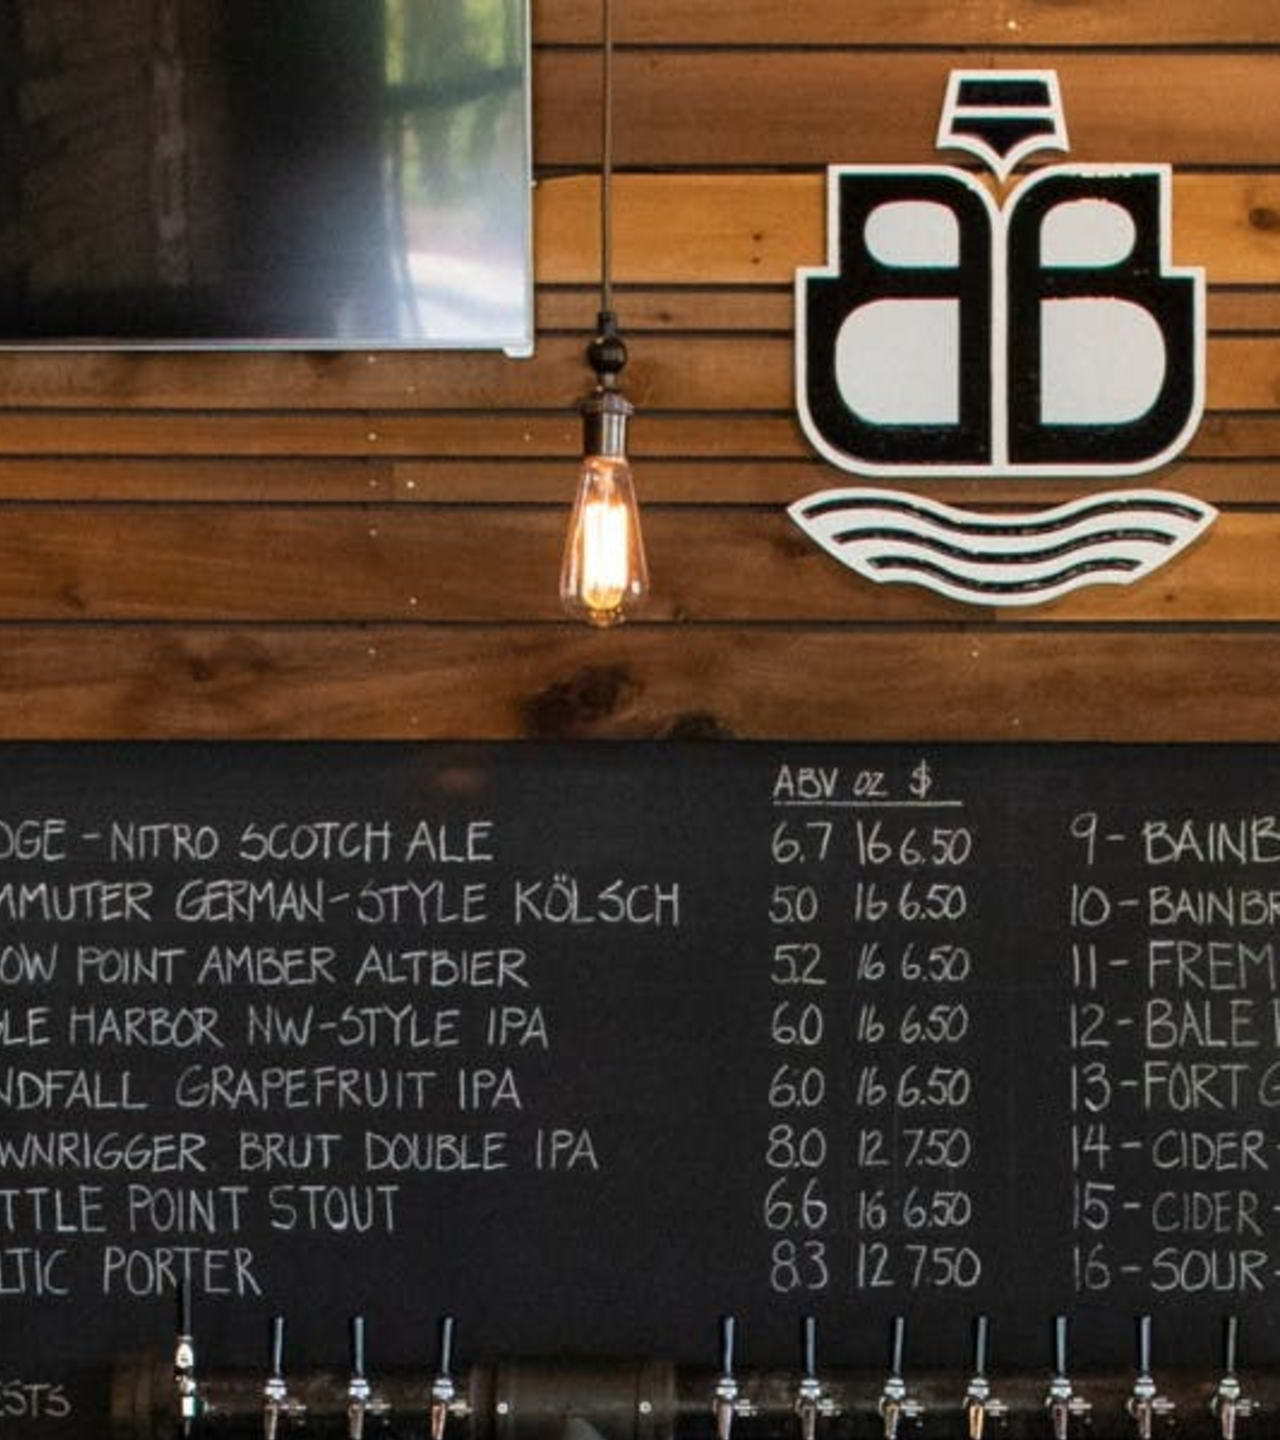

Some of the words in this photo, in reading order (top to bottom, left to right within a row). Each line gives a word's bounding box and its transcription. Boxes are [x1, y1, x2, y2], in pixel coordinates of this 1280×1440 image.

[772, 763, 839, 799] ABV
[908, 758, 934, 800] $
[110, 821, 220, 861] NITRO
[239, 820, 393, 863] SCOTCH
[405, 820, 494, 863] ALE
[770, 821, 833, 864] 6.7
[856, 820, 893, 866] 16
[899, 827, 972, 866] 6.50
[514, 873, 680, 927] KÖLSCH
[854, 882, 889, 922] 16
[898, 881, 968, 922] 6.50
[77, 945, 187, 985] POINT
[197, 945, 336, 986] AMBER
[354, 945, 529, 988] ALTBIER
[857, 942, 886, 981] 16
[901, 942, 971, 983] 6.50
[1148, 939, 1276, 991] FREM
[69, 1006, 225, 1048] HARBOR
[487, 1006, 549, 1049] IPA
[770, 1000, 824, 1046] 6.0
[857, 1004, 885, 1043] 16
[900, 1003, 969, 1045] 6.50
[1145, 997, 1259, 1050] BALE
[175, 1064, 437, 1110] GRAPEFRUIT
[458, 1067, 523, 1110] IPA
[768, 1063, 825, 1108] 6.0
[856, 1066, 888, 1106] 16
[896, 1065, 971, 1108] 6.50
[1143, 1060, 1249, 1112] FORT
[239, 1131, 342, 1172] BRUT
[365, 1131, 508, 1172] DOUBLE
[535, 1128, 600, 1171] IPA
[765, 1123, 827, 1169] 8.0
[858, 1129, 889, 1166] 12
[903, 1127, 972, 1168] 7.50
[1152, 1129, 1269, 1172] CIDER
[128, 1183, 249, 1234] POINT
[268, 1184, 400, 1233] STOUT
[764, 1176, 828, 1231] 6.6
[858, 1190, 887, 1230] 16
[903, 1187, 972, 1230] 6.50
[1152, 1189, 1262, 1236] CIDER
[102, 1245, 263, 1296] PORTER
[857, 1242, 895, 1289] 12
[1150, 1247, 1269, 1293] SOUR
